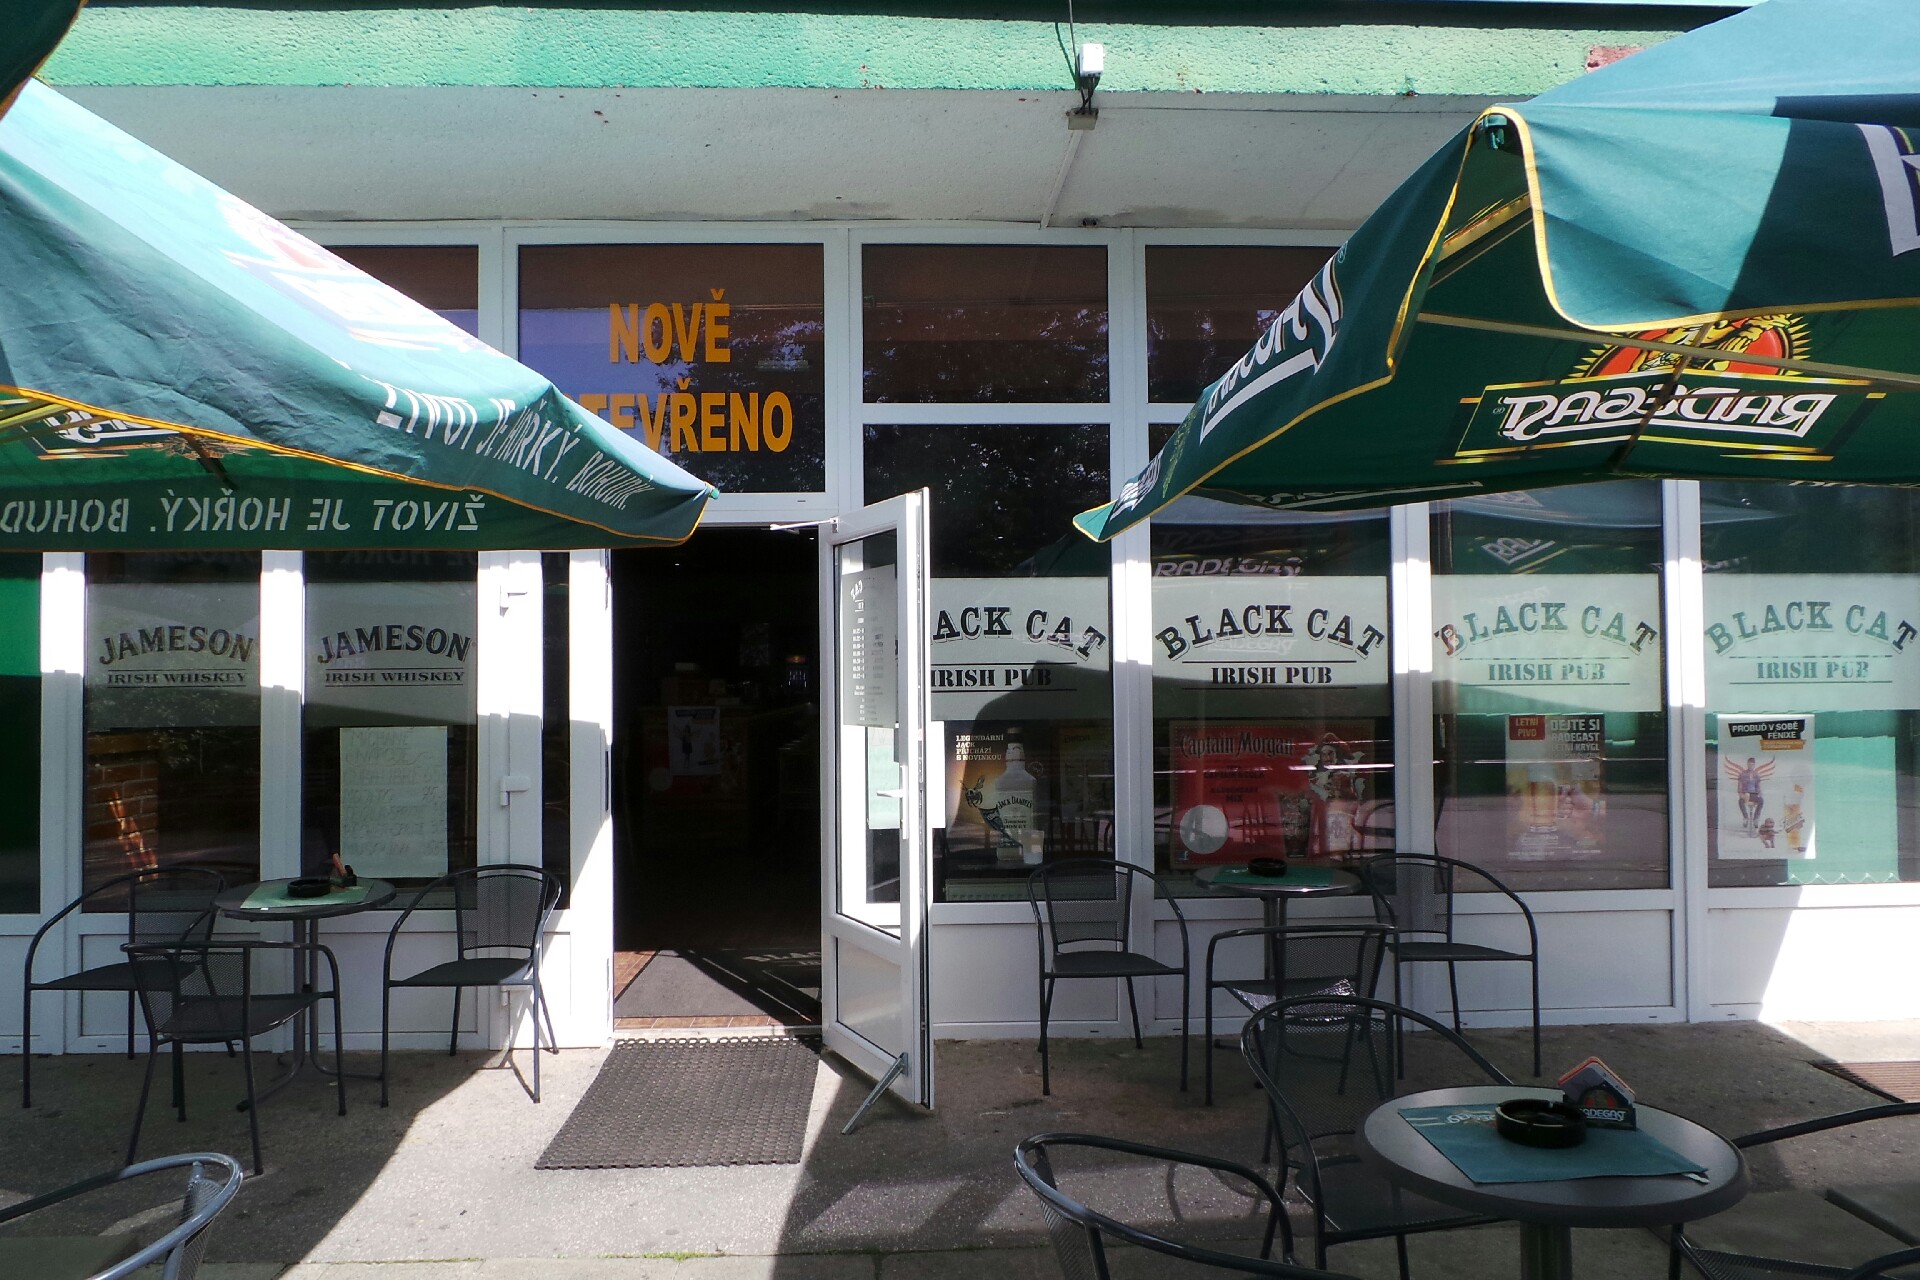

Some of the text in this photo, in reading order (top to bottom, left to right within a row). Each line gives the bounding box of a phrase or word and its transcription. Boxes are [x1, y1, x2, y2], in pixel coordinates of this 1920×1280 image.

[608, 288, 731, 364] NOVĚ
[932, 605, 1107, 662] ACK CAT
[1154, 604, 1386, 661] BLACK CAT
[1435, 601, 1658, 657] BLACK CAT
[1704, 601, 1919, 656] BLACK CAT
[98, 625, 255, 666] JAMESON
[317, 624, 472, 665] JAMESON
[107, 671, 247, 685] IRISH WHISKEY
[325, 671, 465, 684] IRISH WHISKEY
[1004, 668, 1053, 687] PUB
[1211, 666, 1333, 685] IRISH PUB
[1488, 663, 1606, 682] IRISH PUB
[1757, 661, 1869, 680] IRISH PUB
[1518, 728, 1537, 738] PIVO
[1550, 718, 1600, 731] DEJTE SI
[1181, 732, 1294, 758] Captain Morgan
[1551, 732, 1600, 742] RADEGAST
